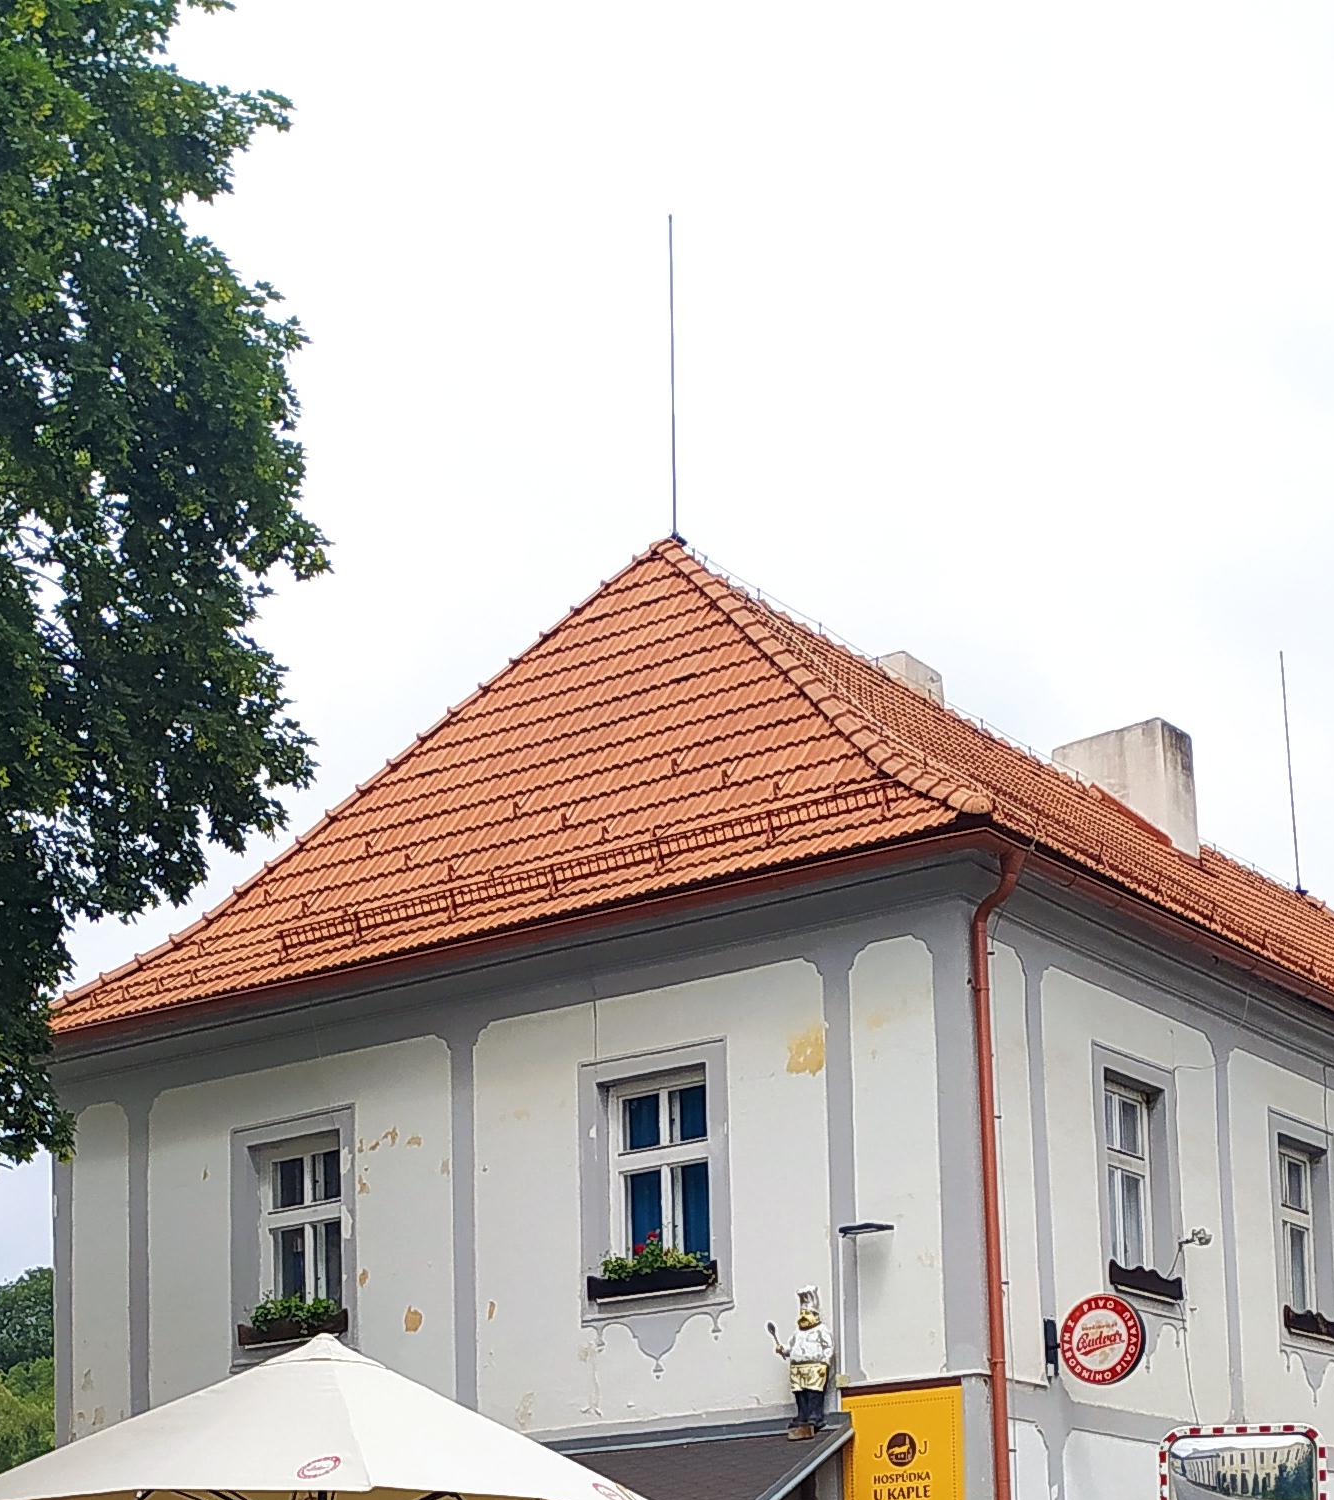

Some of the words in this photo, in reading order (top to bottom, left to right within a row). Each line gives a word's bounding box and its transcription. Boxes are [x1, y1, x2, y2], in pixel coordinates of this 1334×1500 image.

[1082, 1299, 1115, 1313] PIVO
[1076, 1330, 1126, 1356] Budvar
[887, 1485, 931, 1500] KAPLE
